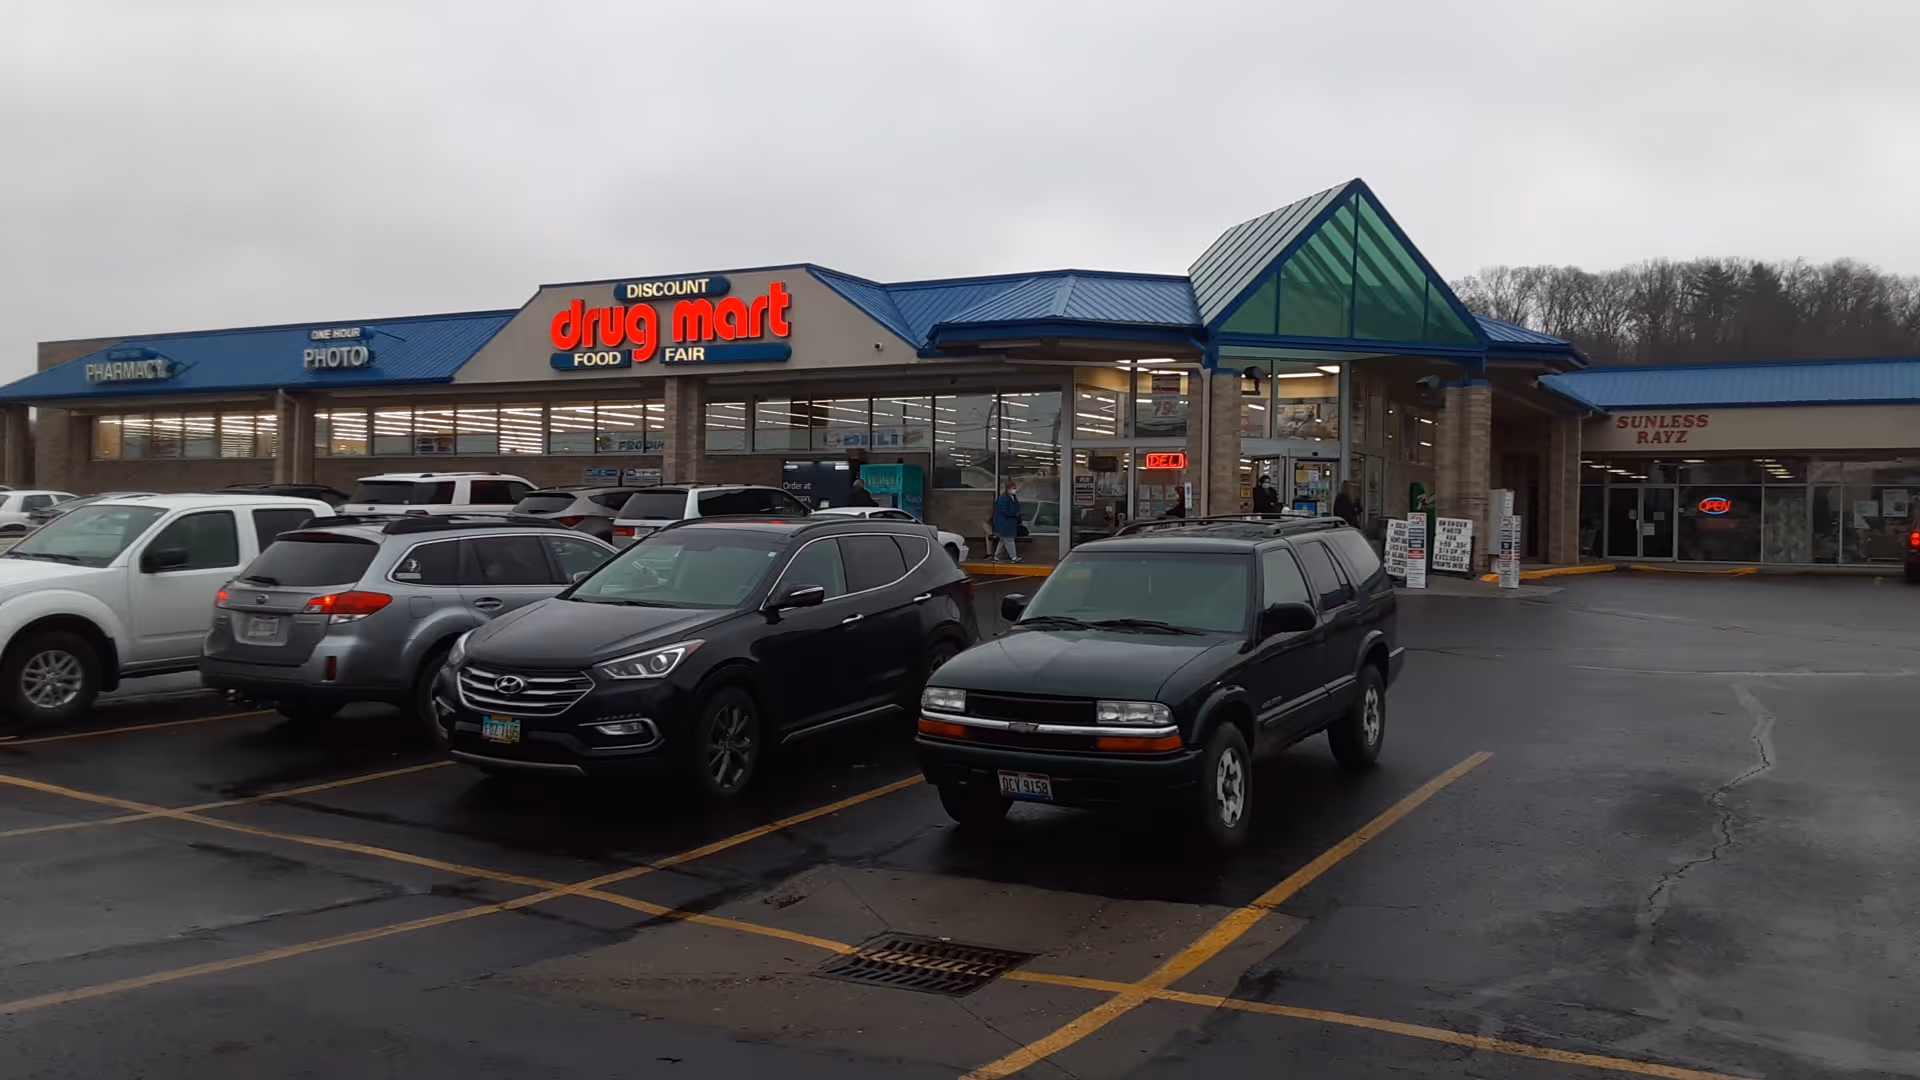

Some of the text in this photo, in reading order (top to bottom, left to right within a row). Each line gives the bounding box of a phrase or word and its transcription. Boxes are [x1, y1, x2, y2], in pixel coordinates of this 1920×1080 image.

[626, 278, 709, 298] DISCOUNT
[550, 281, 792, 362] drug mart
[312, 328, 360, 340] ONE HOUR
[303, 346, 369, 369] PHOTO
[573, 347, 705, 367] FOOD FAIR
[85, 359, 167, 381] PHARMACY
[1616, 414, 1709, 429] SUNLESS
[1635, 430, 1689, 444] RAYZ
[1149, 455, 1181, 467] DELI
[783, 481, 811, 490] Order at
[1698, 500, 1732, 512] OPEN
[1435, 553, 1463, 562] EXCLUDES
[1023, 780, 1049, 795] 9158
